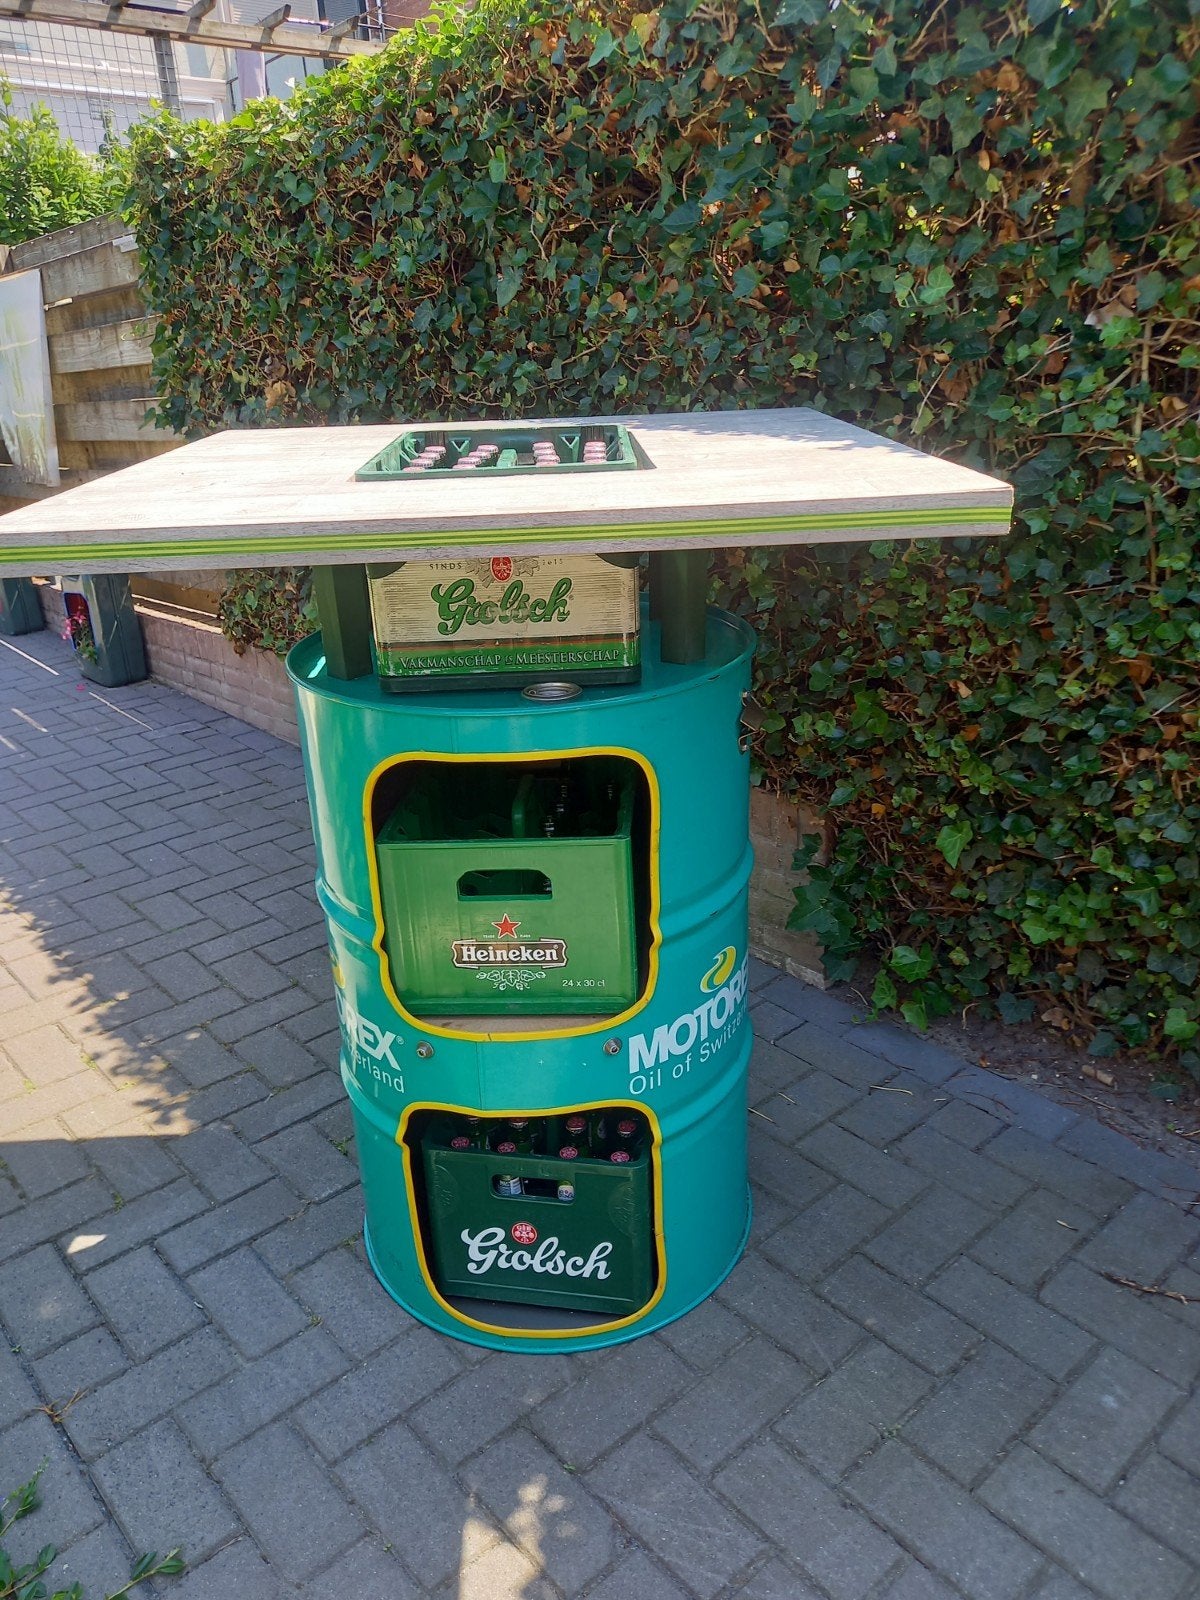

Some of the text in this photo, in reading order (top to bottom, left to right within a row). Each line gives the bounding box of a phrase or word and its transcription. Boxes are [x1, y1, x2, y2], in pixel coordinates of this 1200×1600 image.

[429, 562, 462, 571] SINDS
[430, 577, 573, 636] Grolsch
[399, 654, 501, 669] VAKMANSCHAP
[516, 649, 620, 665] MEESTERSCHAP
[460, 944, 559, 962] Heineken
[562, 979, 574, 987] 24
[584, 979, 595, 987] 30
[346, 1038, 405, 1094] erland
[629, 1068, 661, 1095] Oil
[672, 1053, 692, 1079] of
[460, 1226, 613, 1280] Grolsch
